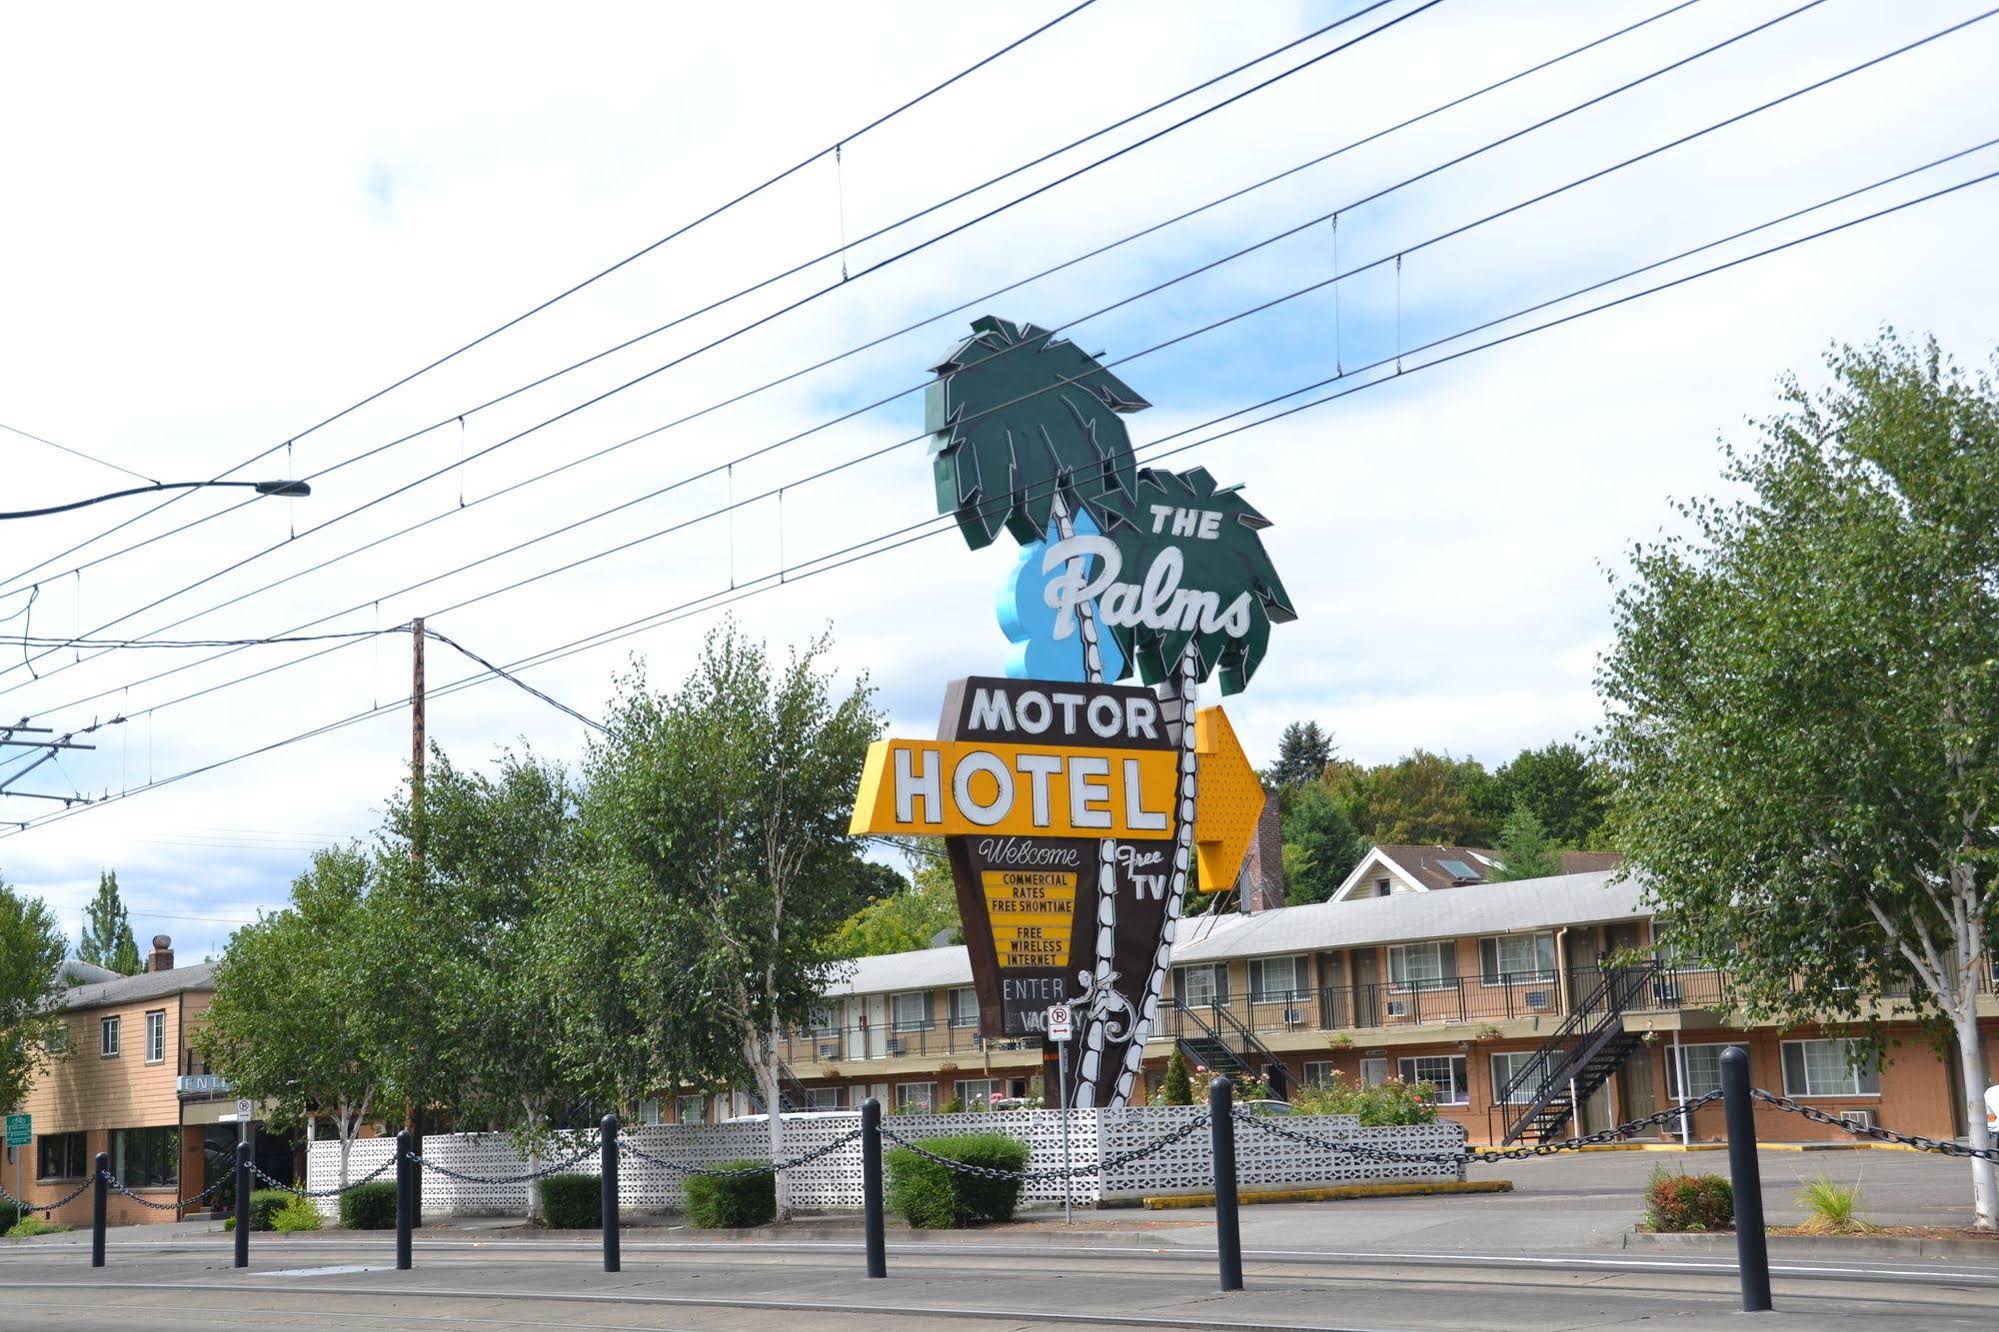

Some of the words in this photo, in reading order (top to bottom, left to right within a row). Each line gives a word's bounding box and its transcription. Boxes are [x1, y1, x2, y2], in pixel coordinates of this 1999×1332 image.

[1150, 504, 1223, 539] THE
[1042, 535, 1252, 640] Palms
[968, 687, 1158, 739] MOTOR
[894, 748, 1168, 830] HOTEL
[978, 836, 1081, 867] Welcome
[1116, 845, 1164, 879] Free
[1003, 873, 1067, 886] COMMERCIAL
[1131, 874, 1167, 900] TV
[1013, 887, 1045, 899] RATES
[992, 900, 1017, 912] FREE
[1019, 900, 1072, 912] SHOWTIME
[1017, 927, 1042, 939] FREE
[1010, 941, 1062, 952] WIRELESS
[1007, 954, 1056, 965] INTERNET
[1003, 978, 1065, 1000] ENTER
[1020, 1010, 1084, 1032] VACY
